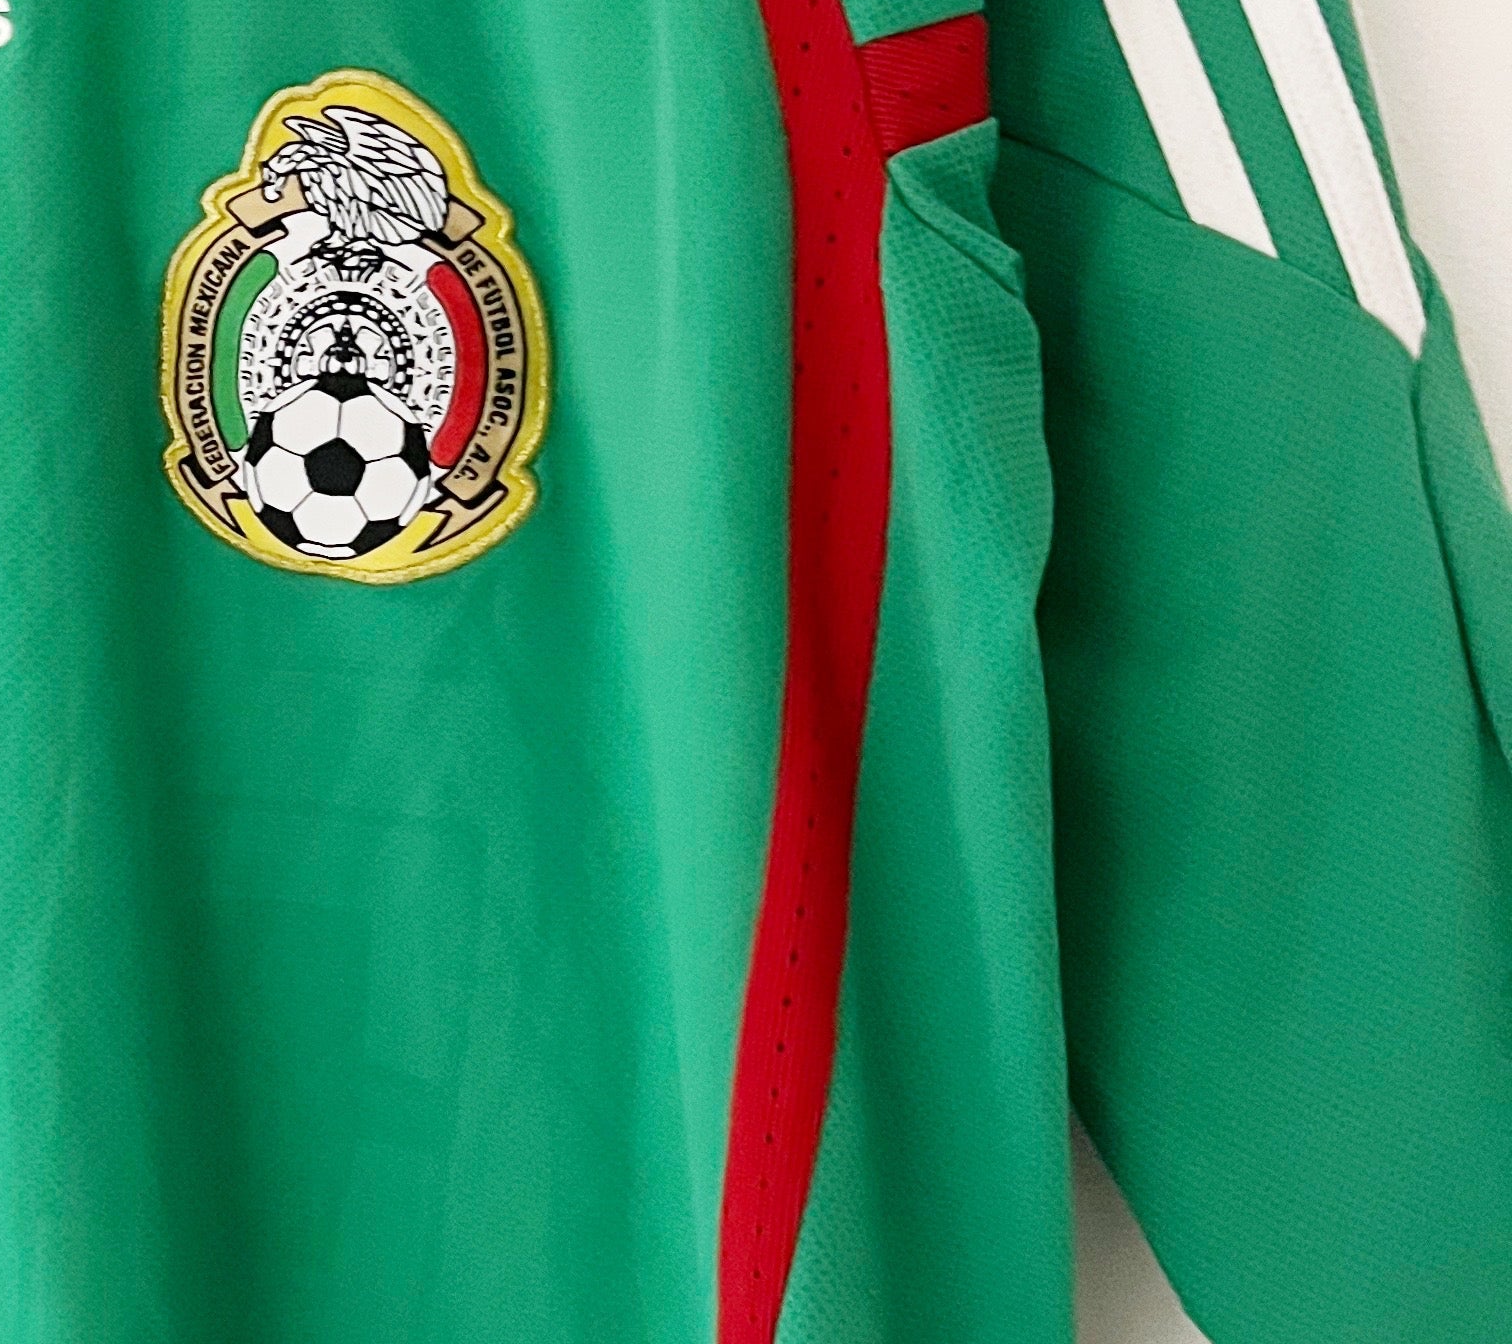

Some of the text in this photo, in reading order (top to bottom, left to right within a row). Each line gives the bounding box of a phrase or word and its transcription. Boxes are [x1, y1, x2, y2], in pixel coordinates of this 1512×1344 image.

[189, 238, 251, 337] MEXICANA
[457, 248, 487, 277] DE
[476, 275, 516, 360] FUTBOL
[185, 343, 230, 475] FEDERACION
[453, 442, 491, 481] A.C.
